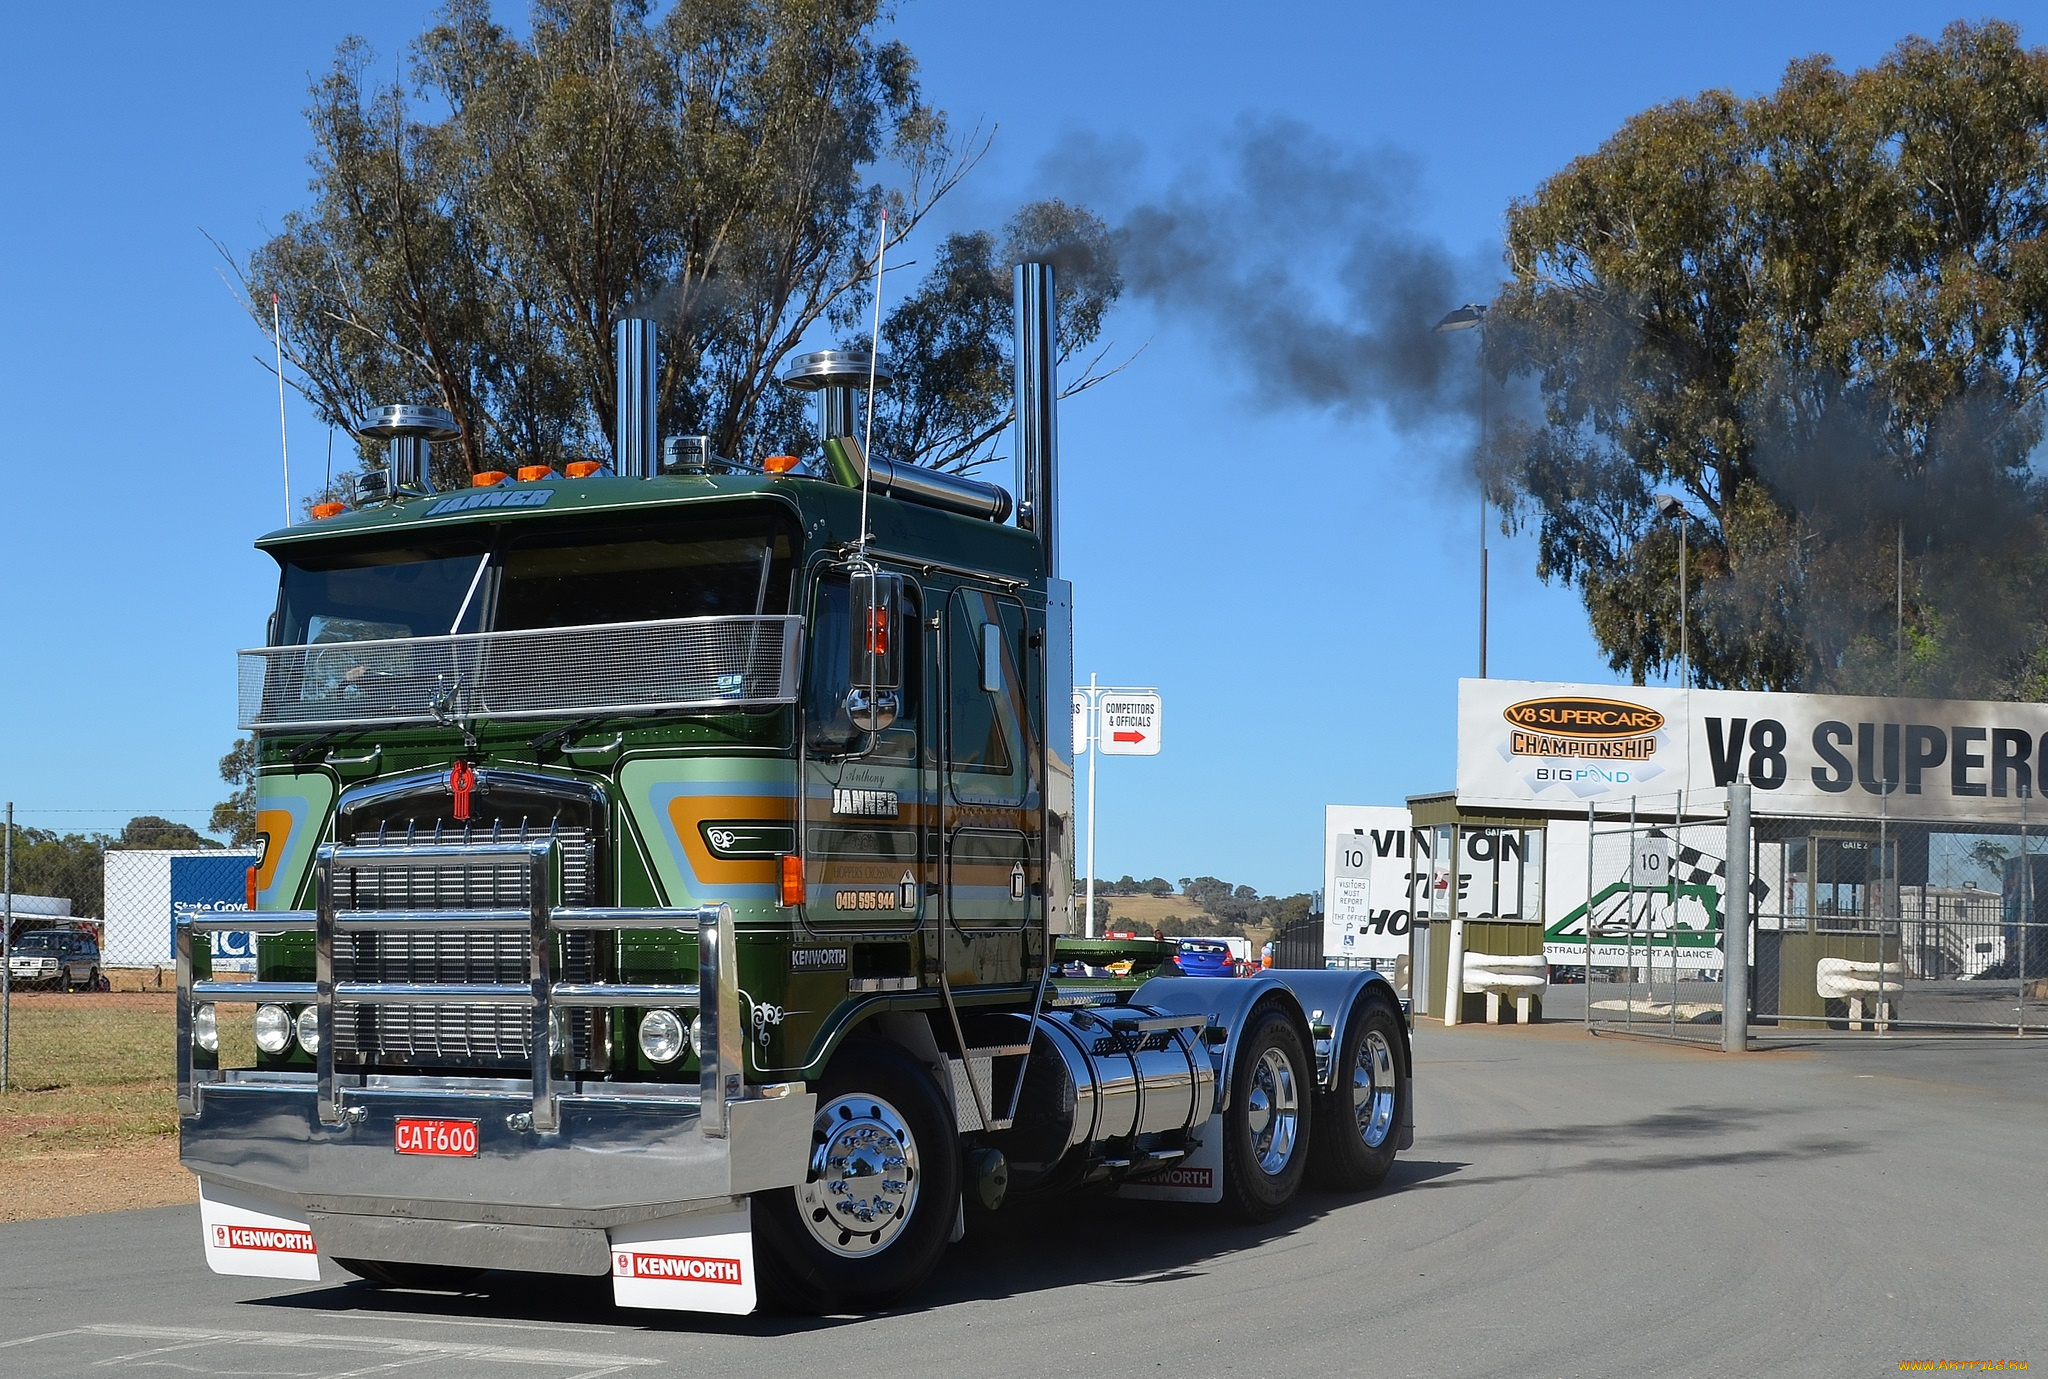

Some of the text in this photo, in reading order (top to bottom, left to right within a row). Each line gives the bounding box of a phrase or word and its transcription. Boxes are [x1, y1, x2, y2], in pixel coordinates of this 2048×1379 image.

[426, 490, 552, 516] JANNER
[1105, 703, 1155, 714] COMPETITORS
[1508, 707, 1662, 728] V8 SUPERCARS
[1109, 716, 1151, 727] & OFFICIALS
[1513, 732, 1655, 759] CHAMPIONSHIP
[1705, 717, 2048, 798] V8 SUPER
[845, 768, 885, 788] Anthony
[832, 788, 899, 816] JANNER
[1842, 841, 1862, 849] GATE
[1344, 850, 1363, 868] 10
[1641, 853, 1660, 871] 10
[834, 866, 896, 879] HOPPERS CROSSING
[1339, 881, 1366, 889] VISITORS
[836, 891, 895, 911] 0419 595 944
[1346, 914, 1367, 922] OFFICE
[792, 949, 846, 966] KENWORTH
[1542, 946, 1713, 959] USTRALIAN AUTO-SPORT ALLIANCE
[1140, 1171, 1210, 1184] NWORTH
[231, 1229, 314, 1251] KENWORTH
[637, 1257, 738, 1281] KENWORTH
